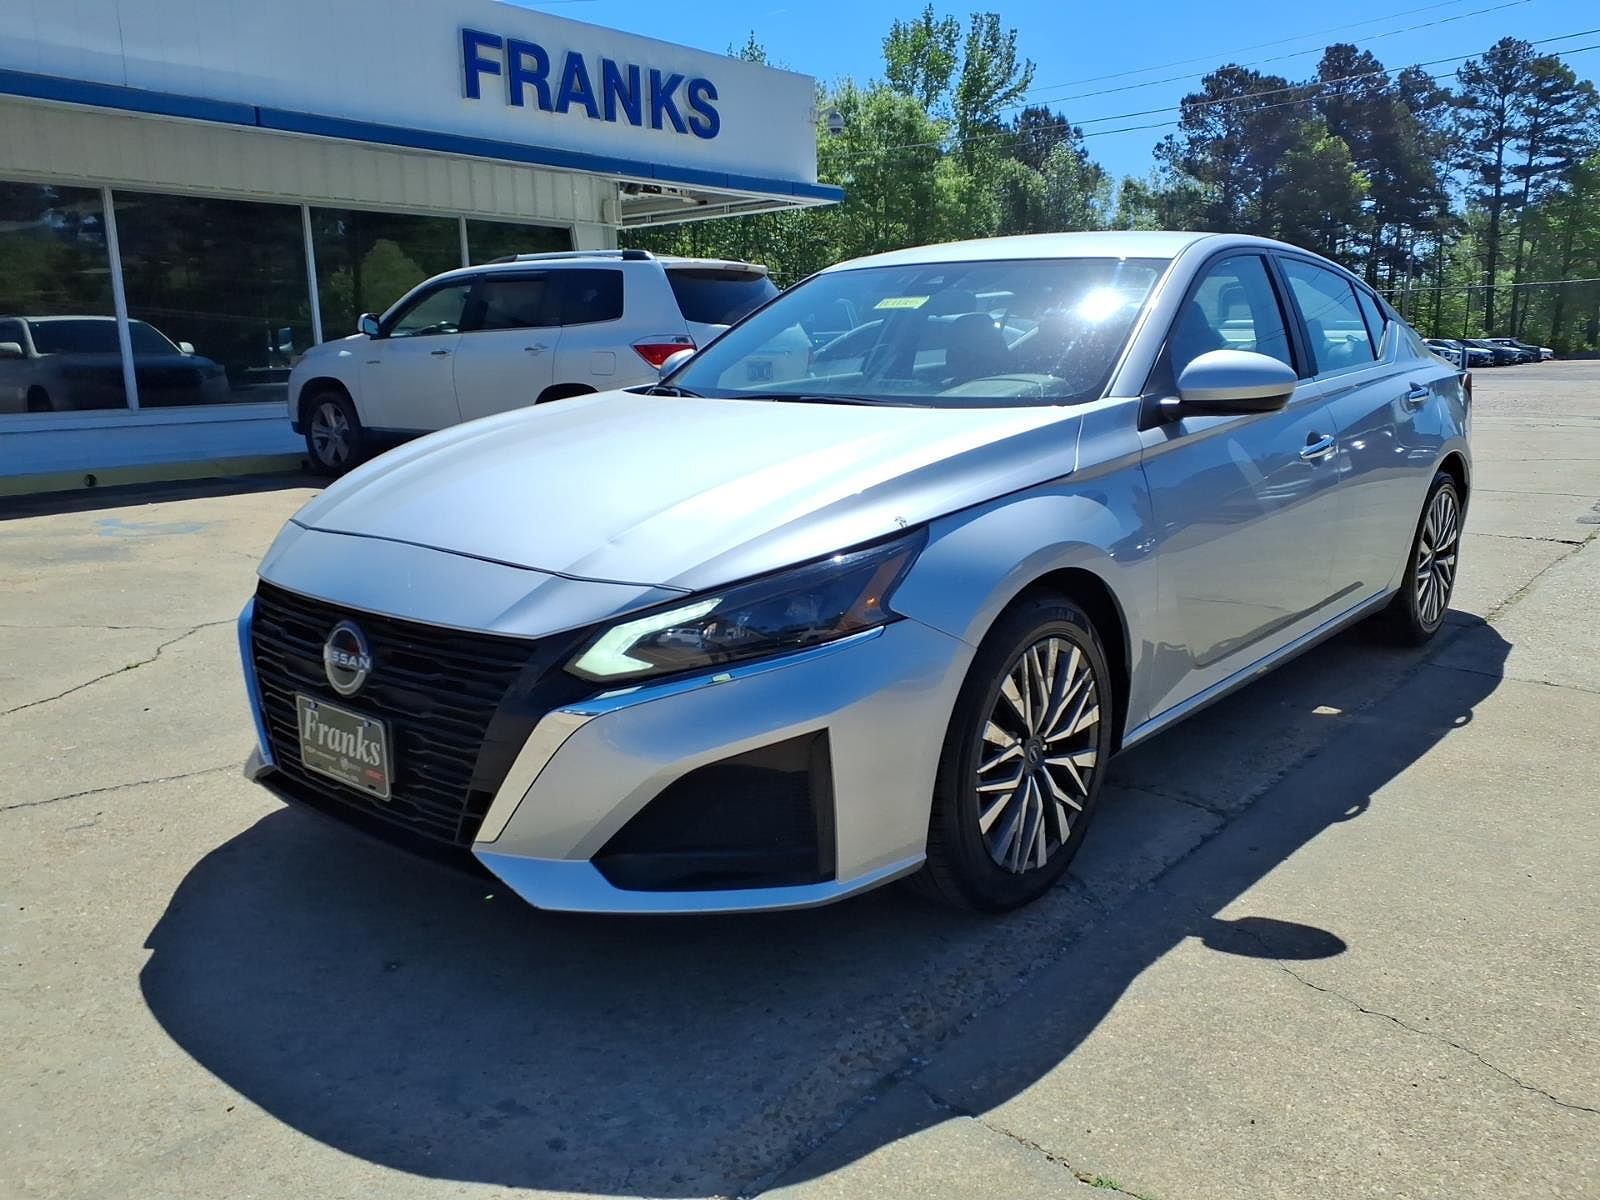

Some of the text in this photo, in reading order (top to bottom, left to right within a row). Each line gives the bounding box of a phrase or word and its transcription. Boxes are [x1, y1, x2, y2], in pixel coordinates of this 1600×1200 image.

[462, 28, 721, 139] FRANKS
[325, 646, 371, 669] SSAN
[303, 707, 381, 766] Franks
